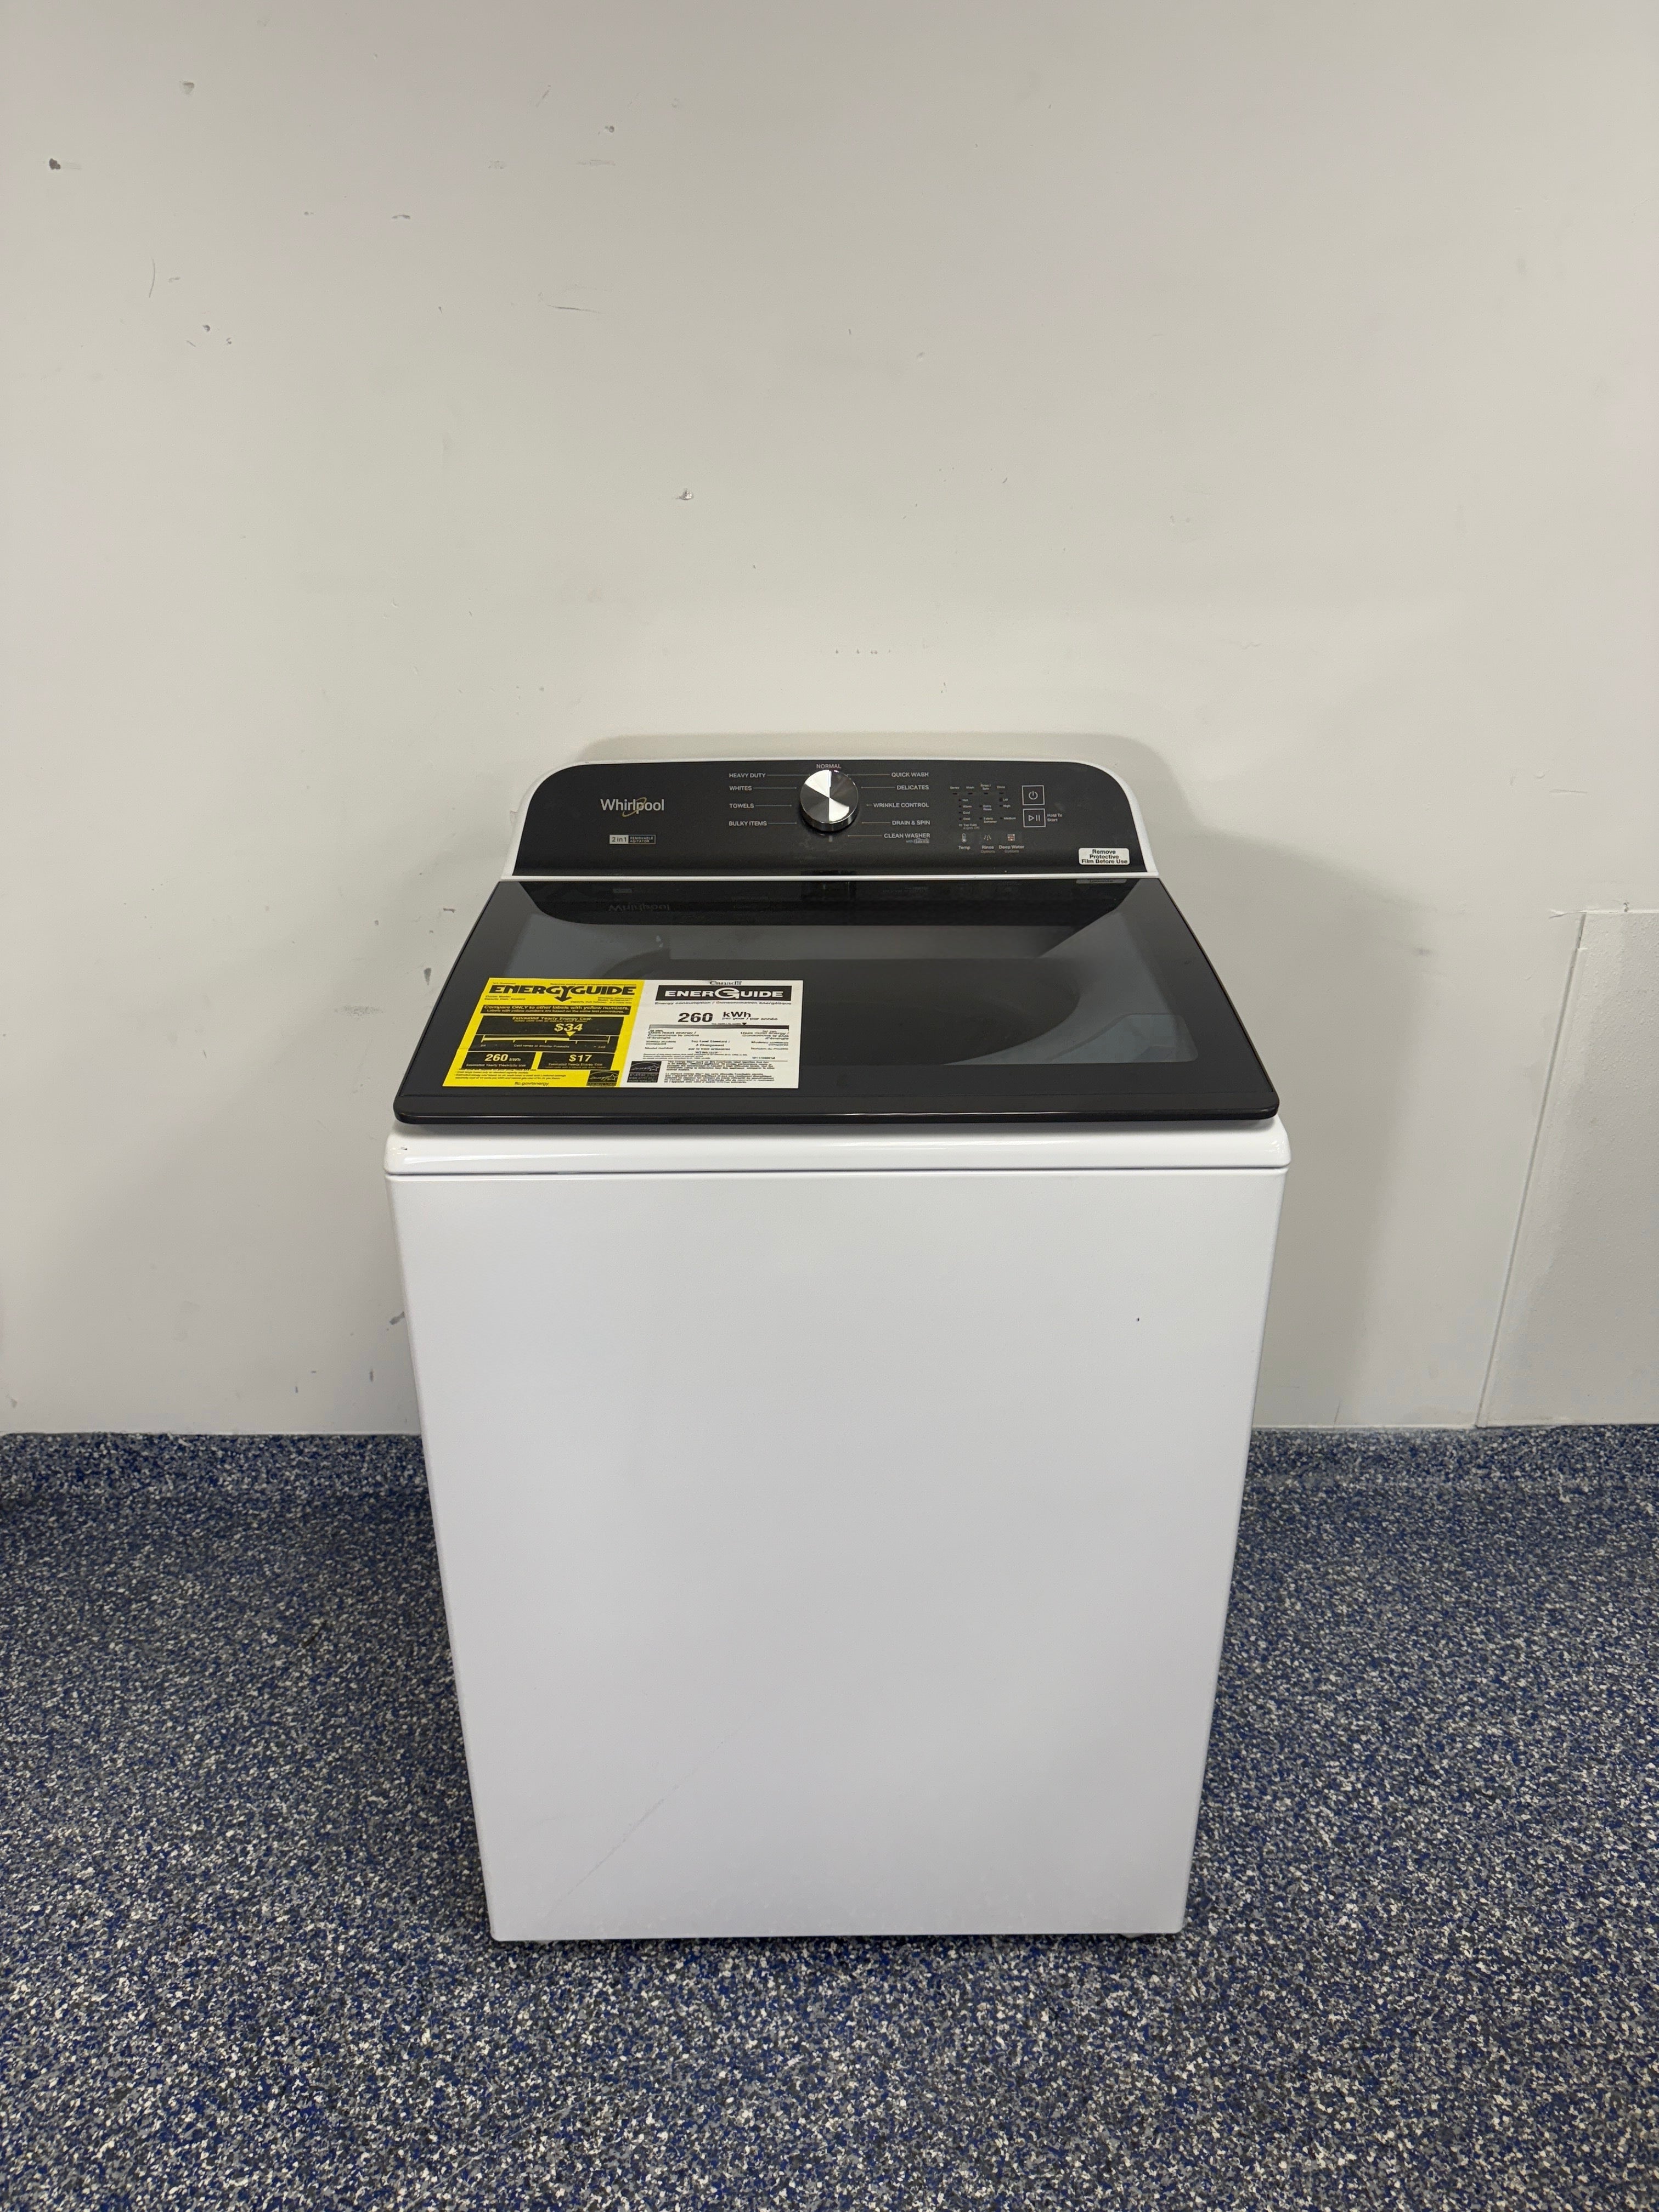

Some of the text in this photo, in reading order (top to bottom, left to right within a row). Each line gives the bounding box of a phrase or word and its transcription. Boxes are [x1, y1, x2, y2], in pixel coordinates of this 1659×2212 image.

[600, 798, 664, 815] Whirlpool
[489, 985, 636, 998] ENERGYGUIDE
[664, 988, 783, 999] ENERGUIDE
[678, 1013, 713, 1023] 260
[554, 1023, 583, 1032] $34
